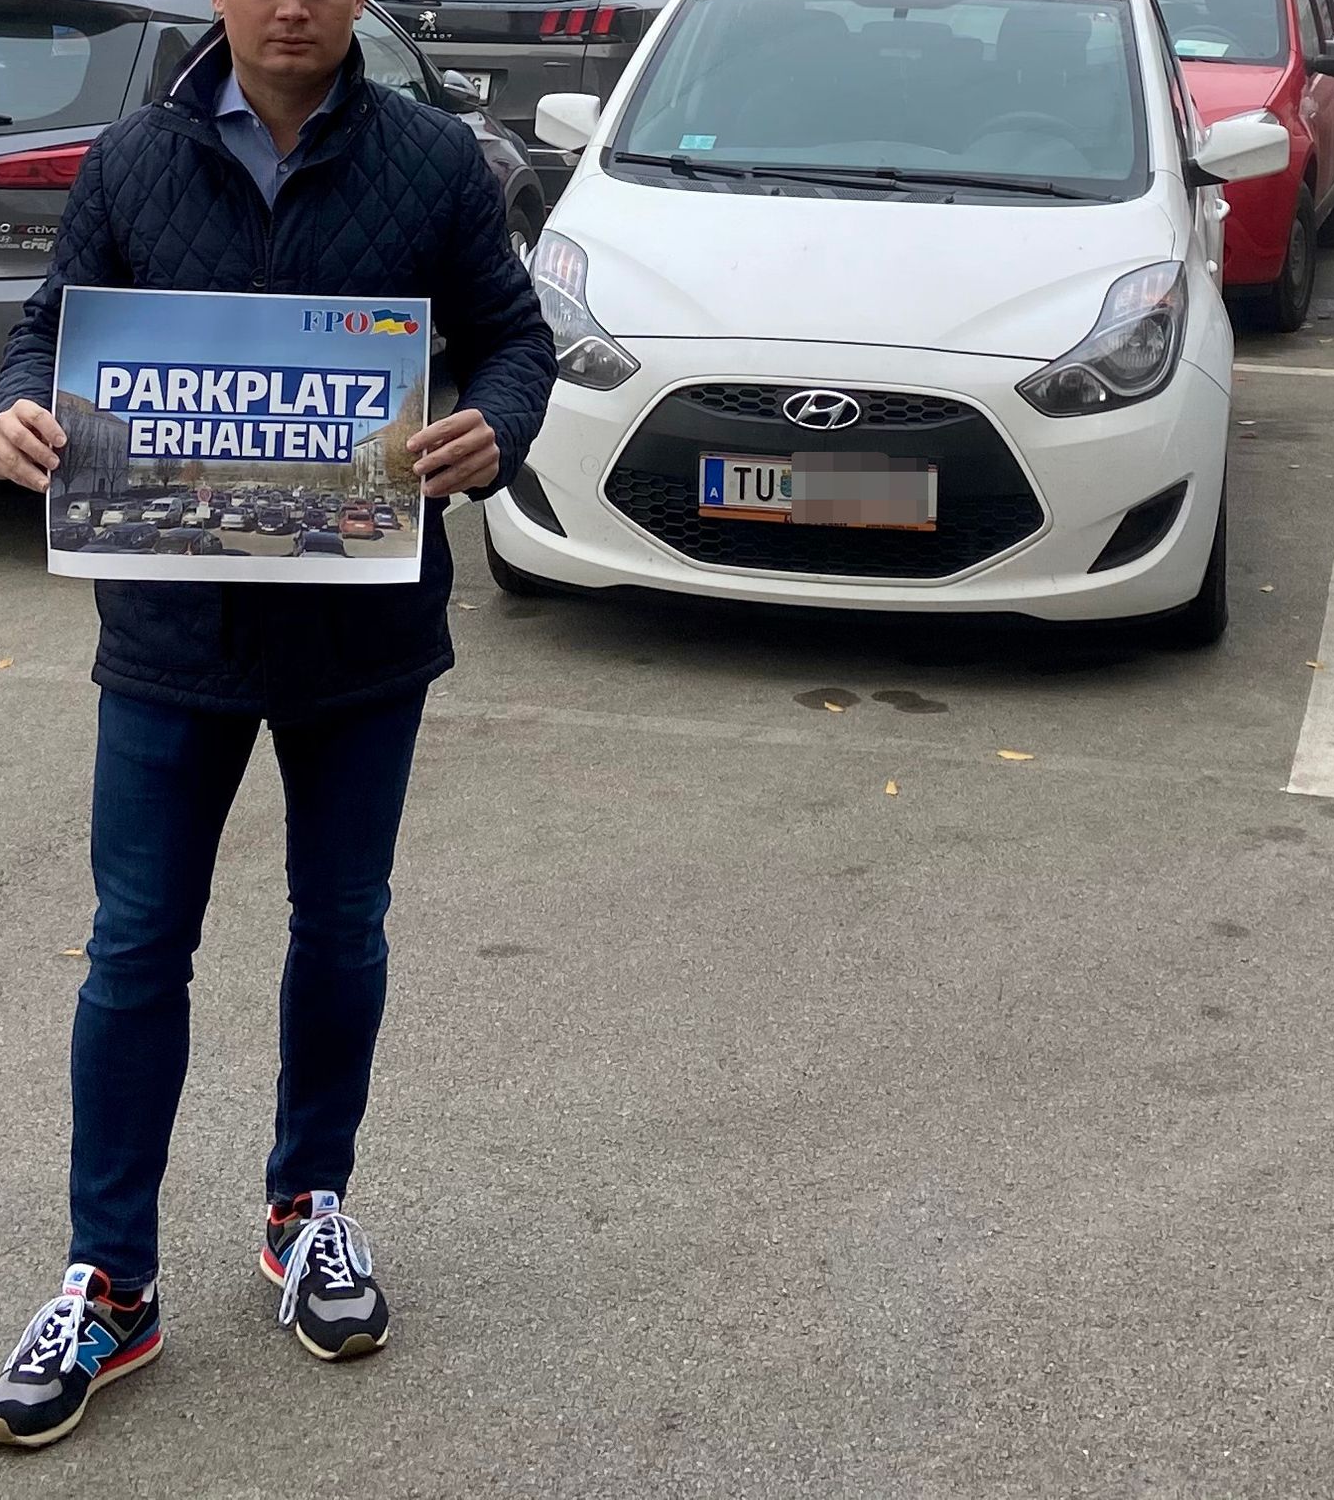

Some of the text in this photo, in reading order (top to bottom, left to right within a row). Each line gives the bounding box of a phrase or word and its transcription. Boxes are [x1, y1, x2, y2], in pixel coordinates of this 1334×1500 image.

[21, 240, 54, 252] Graf
[98, 367, 385, 417] PARKPLATZ
[130, 419, 349, 460] ERHALTEN!
[709, 486, 719, 499] A
[733, 466, 775, 501] TU
